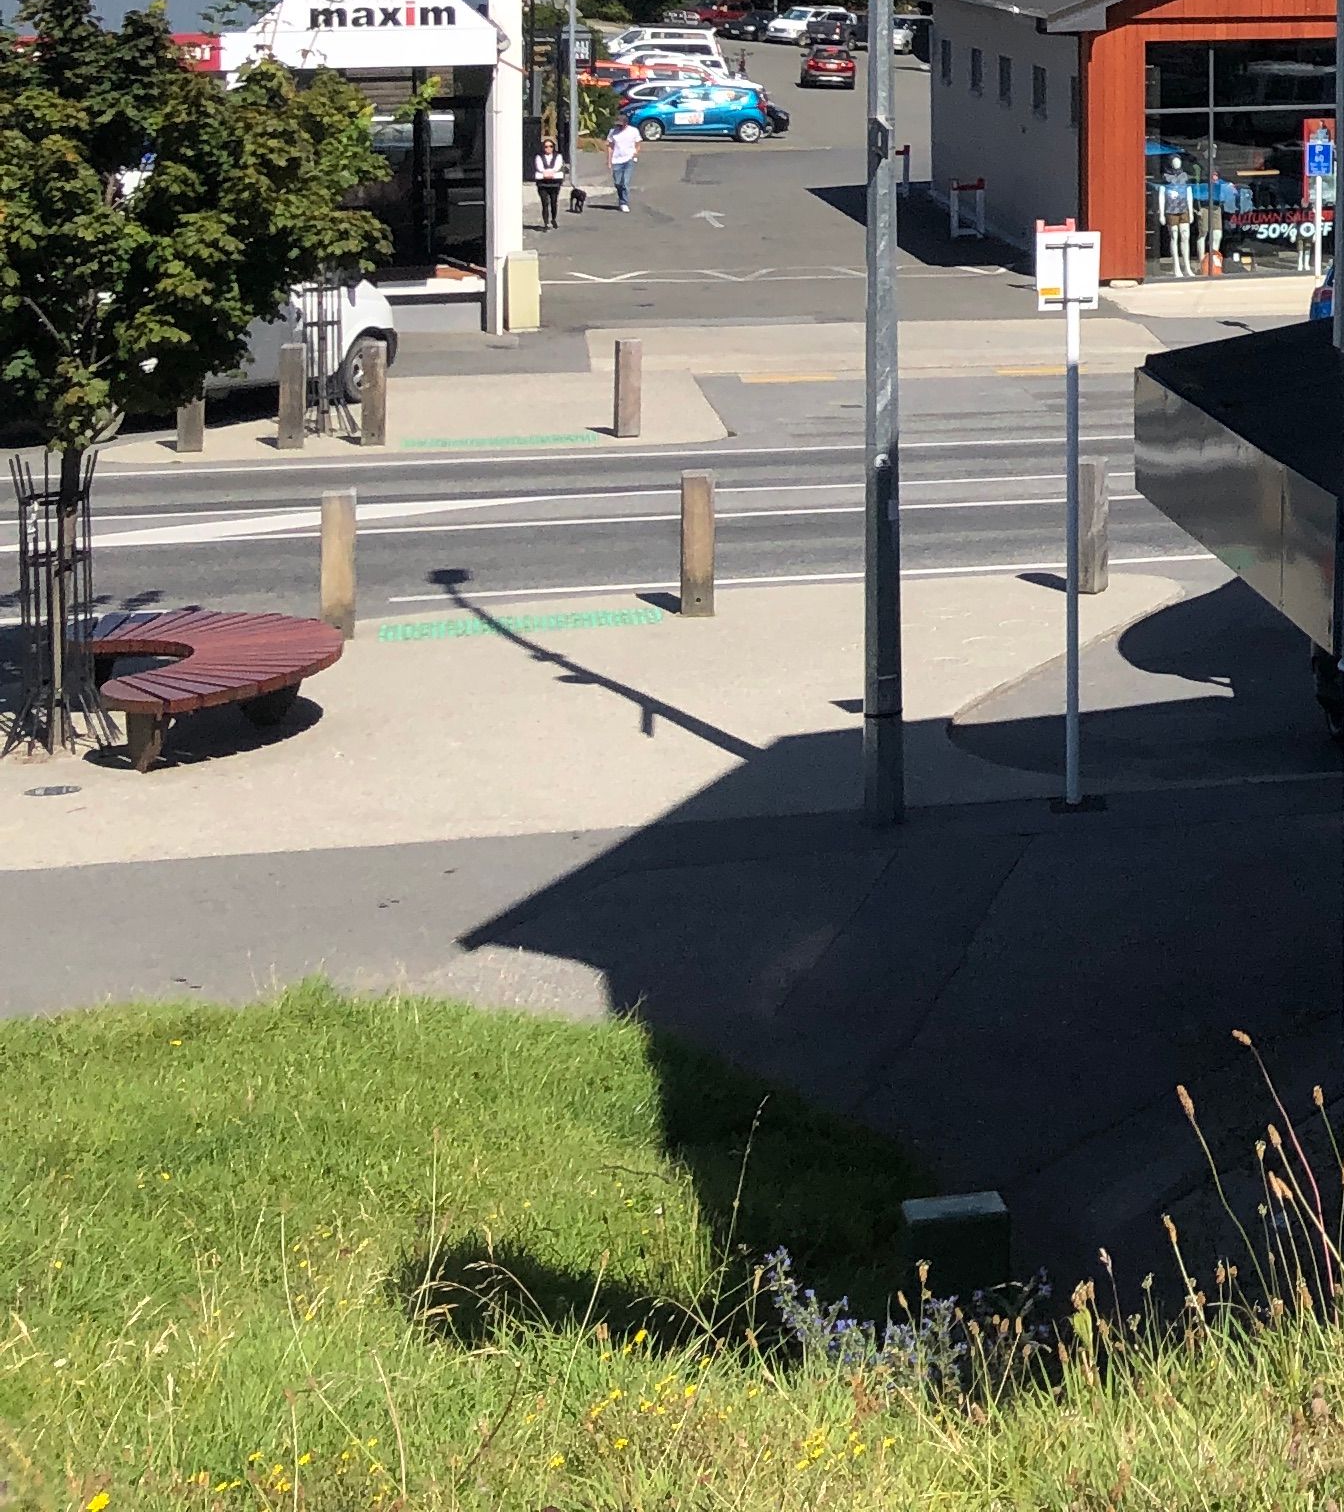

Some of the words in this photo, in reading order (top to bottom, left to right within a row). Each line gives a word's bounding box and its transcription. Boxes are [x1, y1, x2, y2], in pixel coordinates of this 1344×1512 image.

[310, 0, 456, 28] maxim
[1230, 211, 1281, 225] AUTUMN
[1256, 222, 1297, 240] 50%
